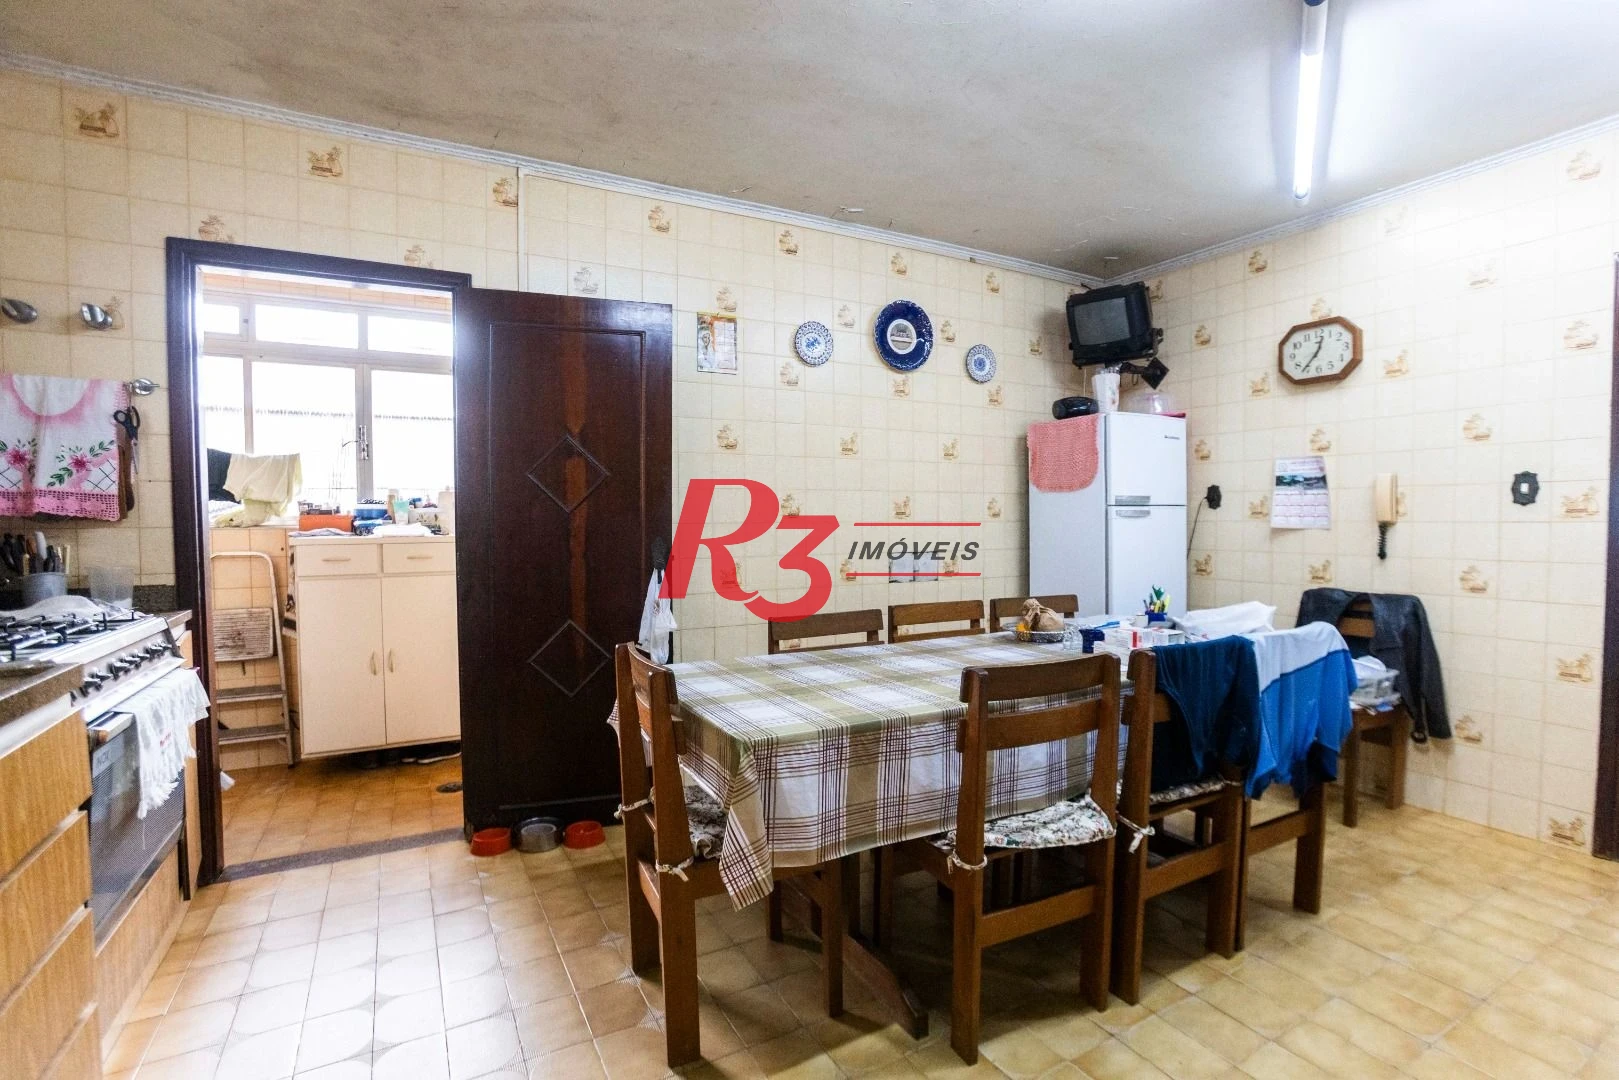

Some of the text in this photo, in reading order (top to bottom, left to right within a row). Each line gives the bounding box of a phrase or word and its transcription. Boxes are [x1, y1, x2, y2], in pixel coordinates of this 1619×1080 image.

[1336, 331, 1343, 341] 2
[1343, 341, 1350, 351] 3
[1327, 360, 1335, 370] 5
